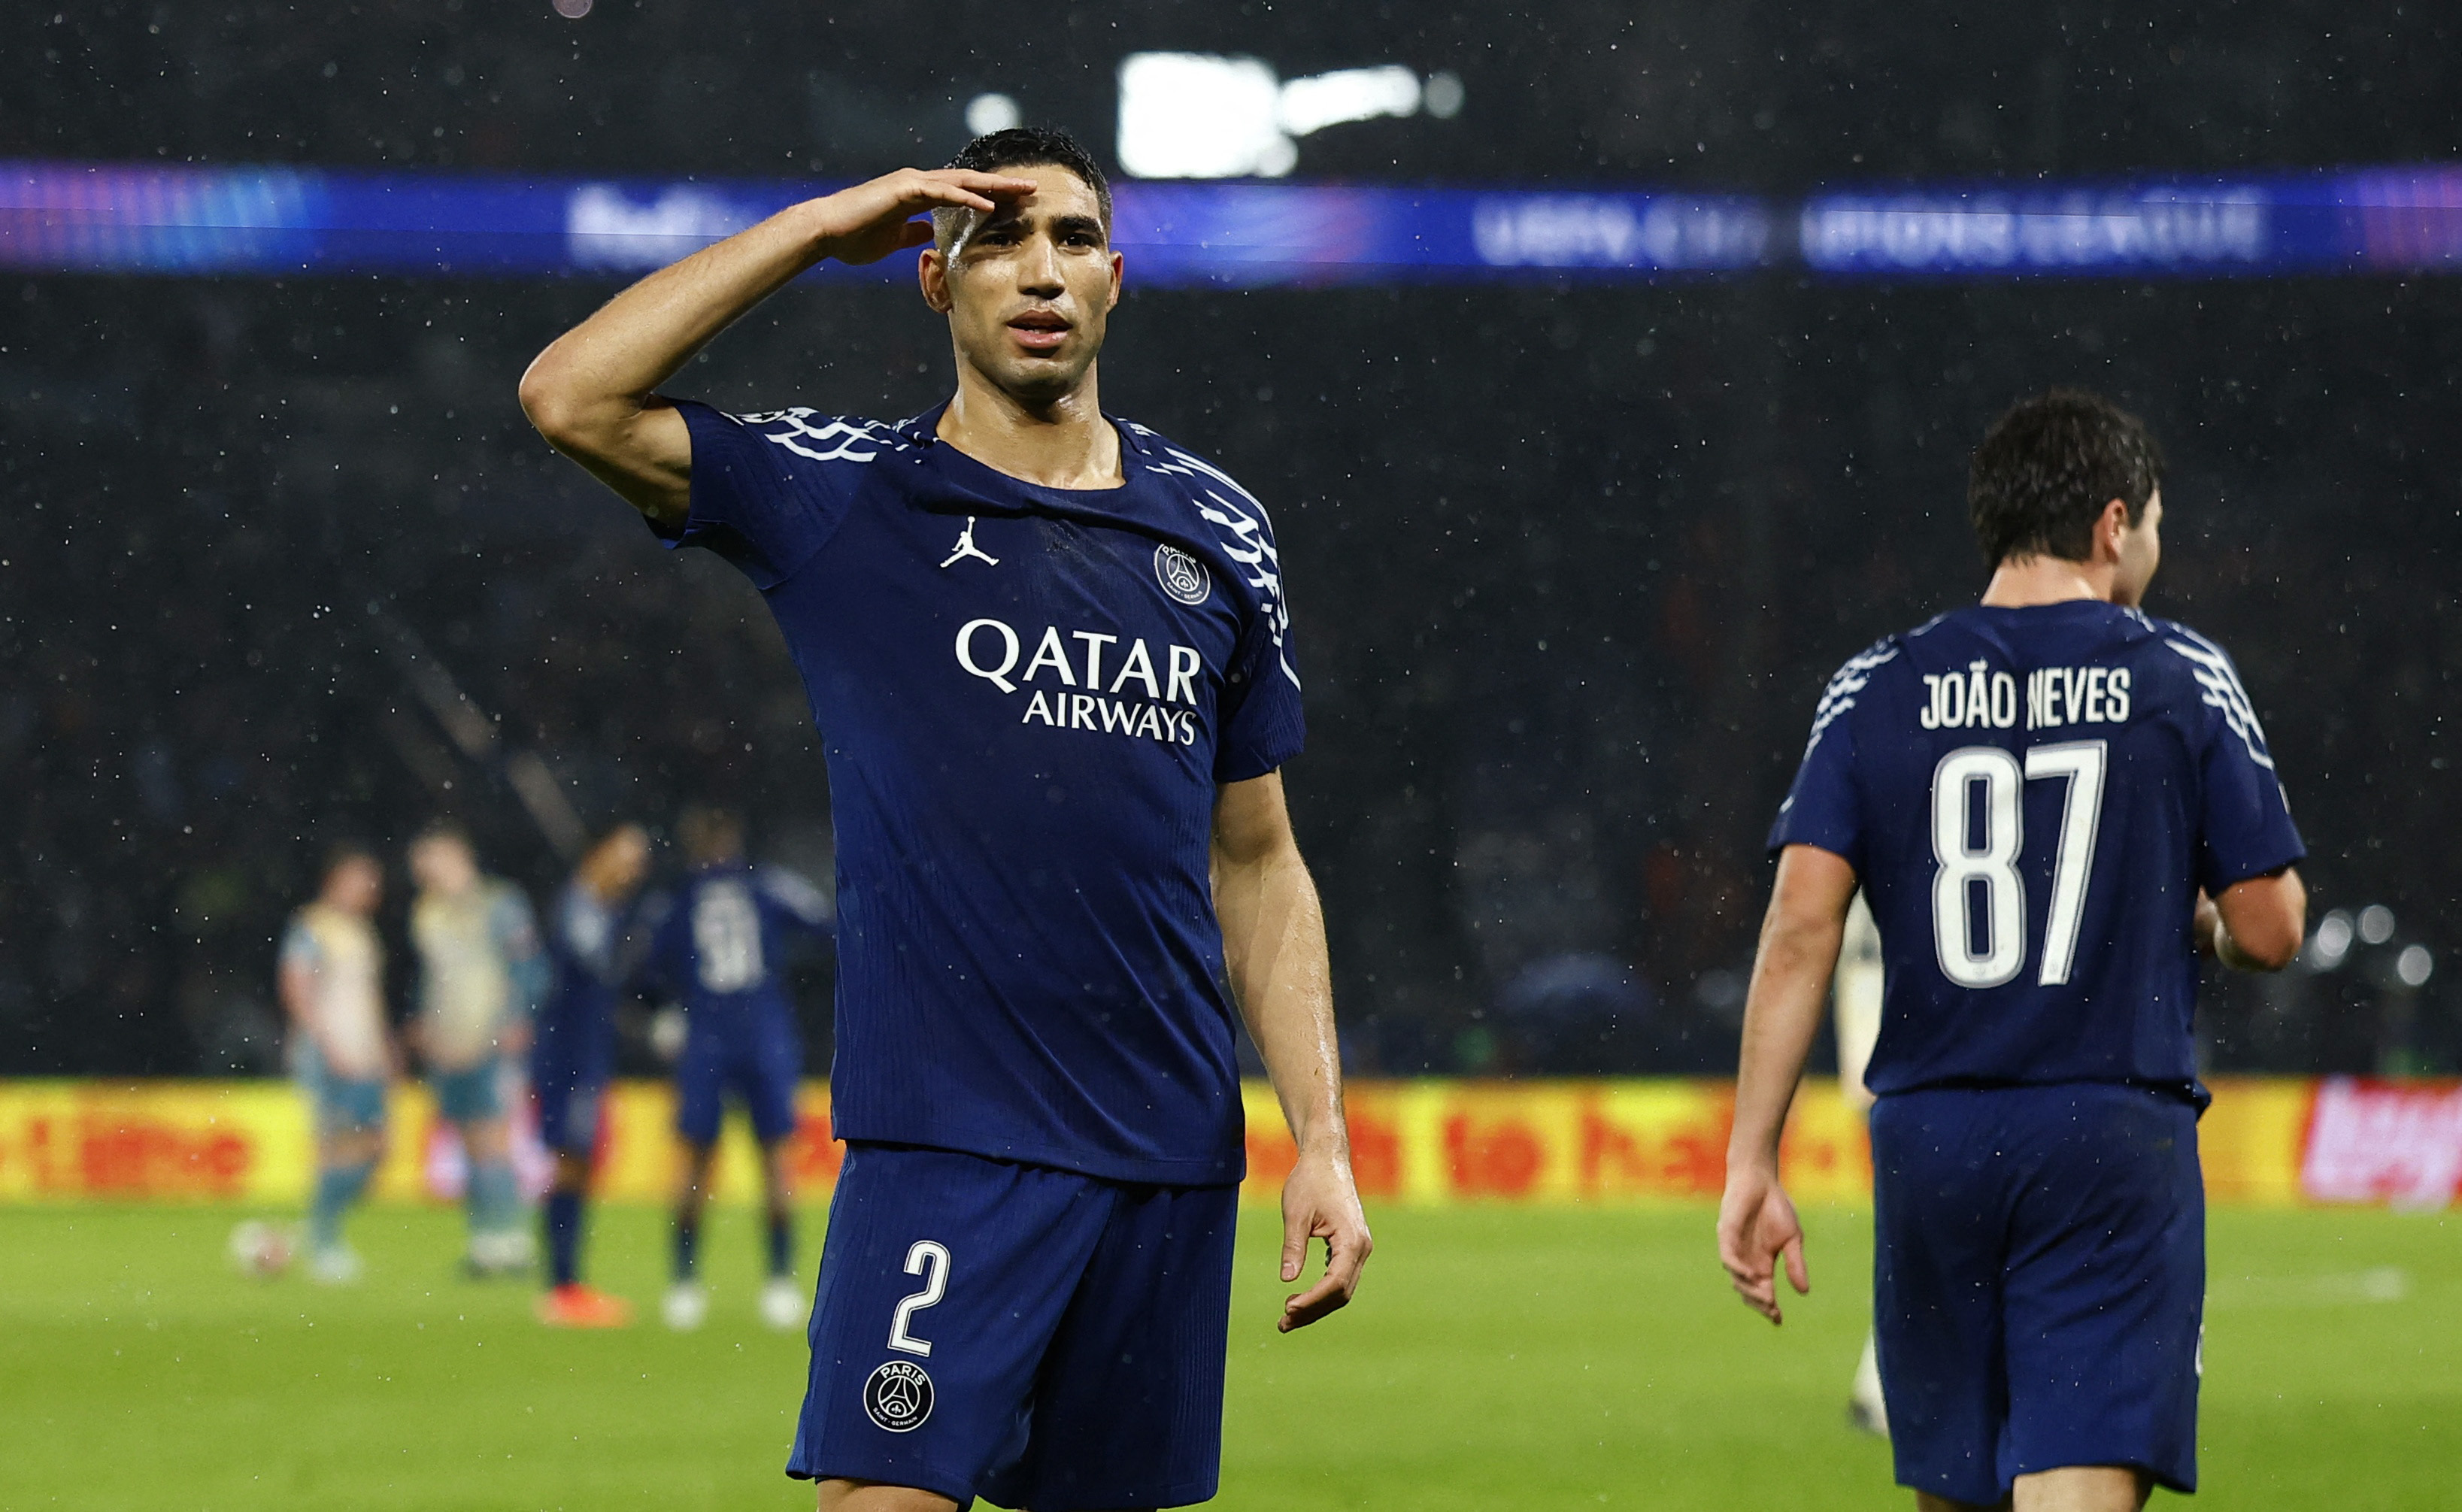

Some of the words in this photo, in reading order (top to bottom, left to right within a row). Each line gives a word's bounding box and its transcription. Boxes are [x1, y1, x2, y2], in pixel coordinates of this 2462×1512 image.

[955, 619, 1201, 706] QATAR
[1921, 657, 2017, 730] JOÃO
[2027, 667, 2131, 731] NEVES
[1022, 689, 1196, 747] AIRWAYS
[1931, 739, 2107, 989] 87
[887, 1240, 951, 1357] 2
[880, 1364, 926, 1386] PARIS
[872, 1407, 888, 1423] SAINT
[891, 1416, 918, 1426] GERMAIN
